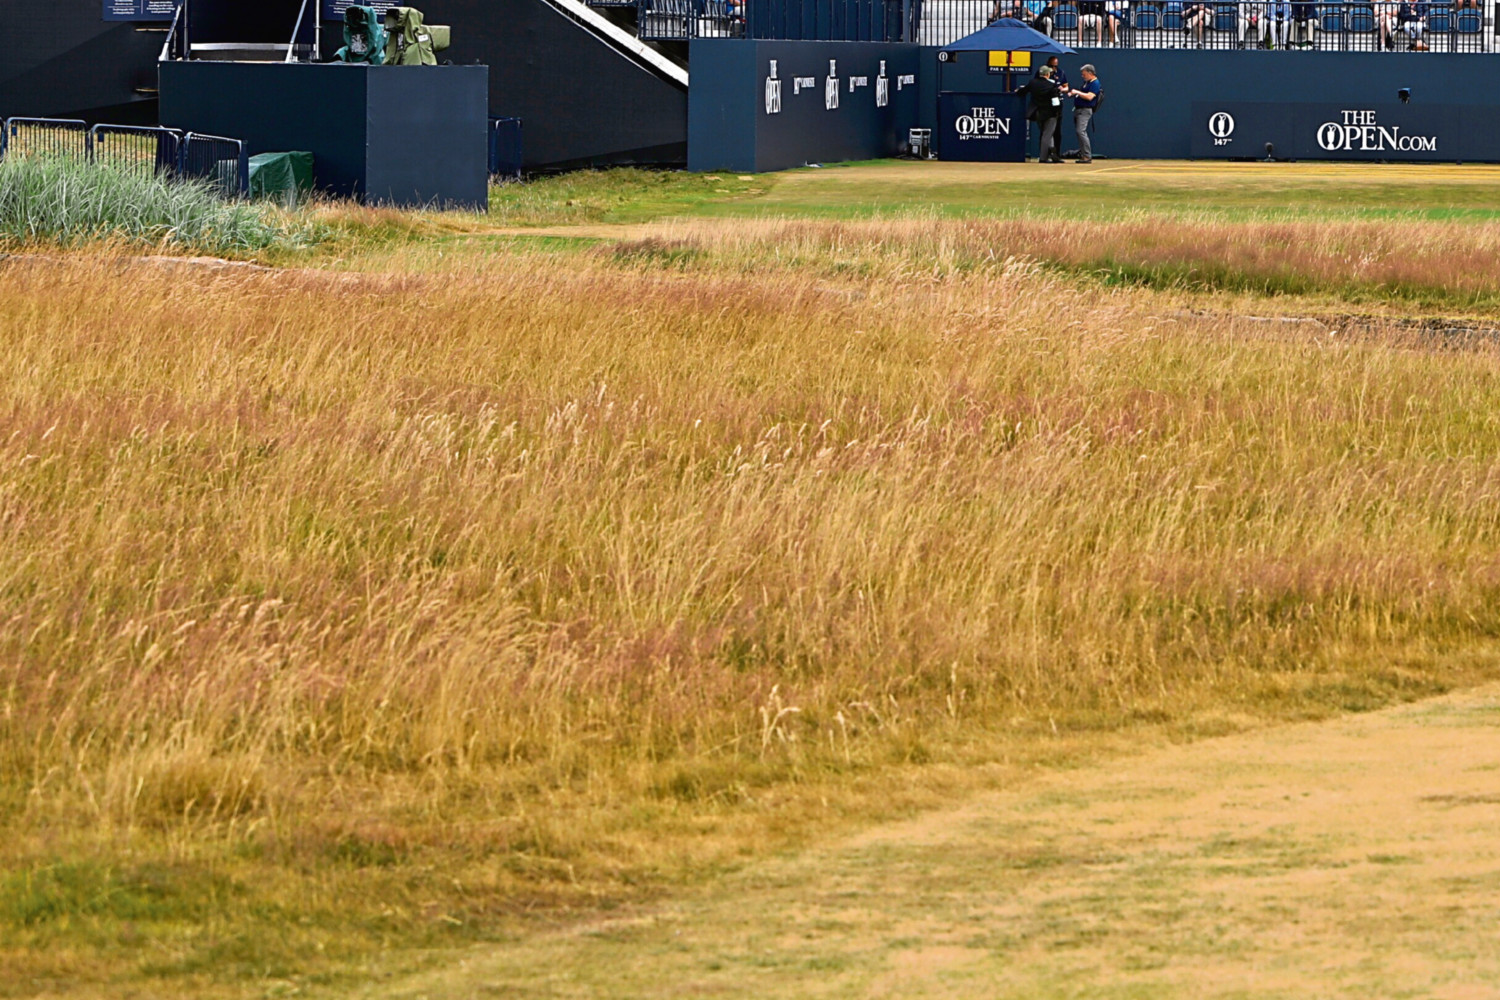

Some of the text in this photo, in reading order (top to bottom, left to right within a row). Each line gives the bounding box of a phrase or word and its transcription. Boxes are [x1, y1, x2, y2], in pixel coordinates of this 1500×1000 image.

[971, 107, 995, 118] THE
[1341, 110, 1376, 125] THE
[955, 115, 1011, 134] OPEN
